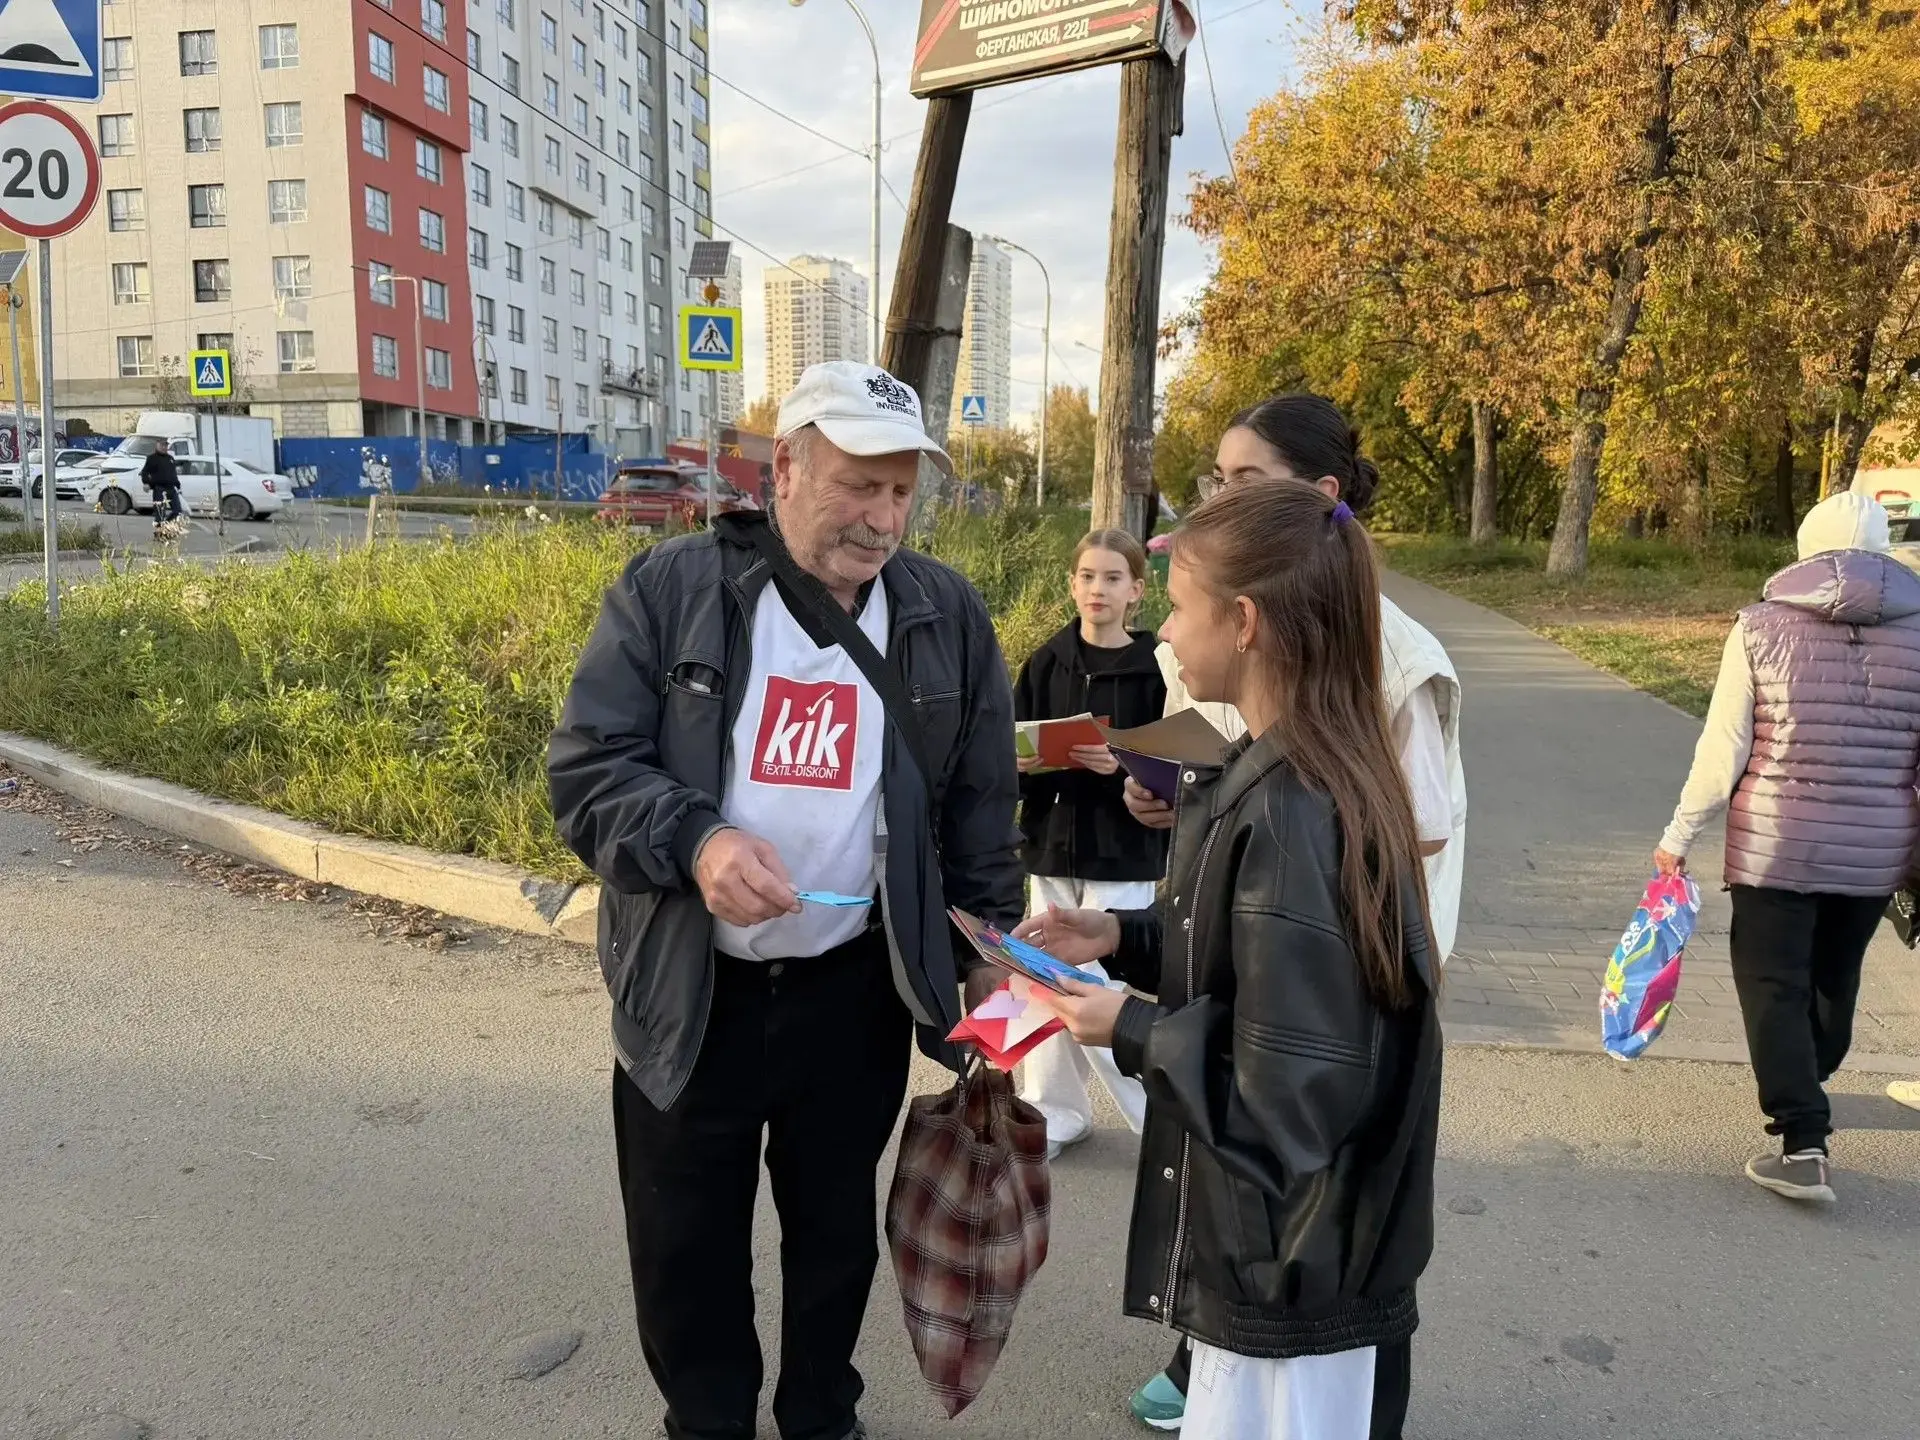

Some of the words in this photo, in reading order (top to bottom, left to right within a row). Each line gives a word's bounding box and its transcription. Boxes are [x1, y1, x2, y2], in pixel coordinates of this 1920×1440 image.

[959, 0, 1084, 30] ШИНОМО
[976, 24, 1060, 58] ФЕРГАНСКАЯ,
[1062, 18, 1089, 40] 22Д
[2, 147, 69, 200] 20
[876, 401, 917, 418] INVERNESS
[763, 688, 849, 768] kik
[761, 762, 839, 780] TEXTIL-DISKONT
